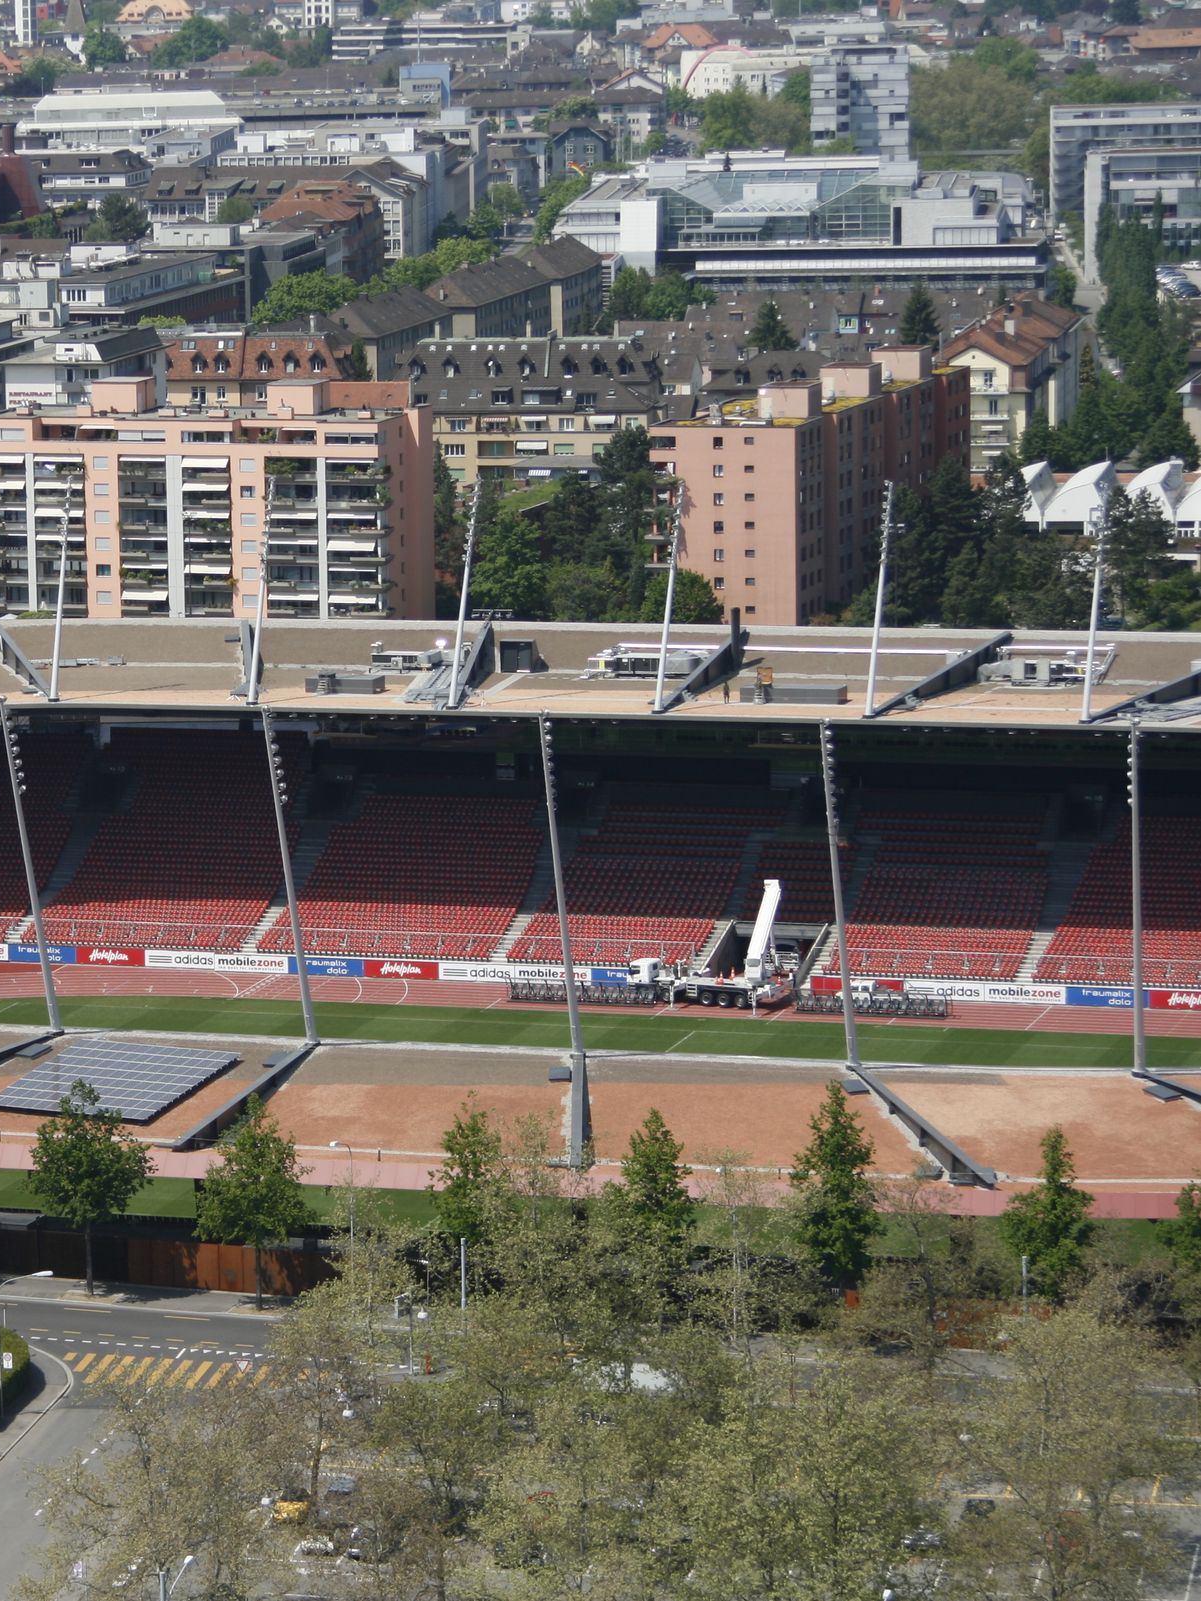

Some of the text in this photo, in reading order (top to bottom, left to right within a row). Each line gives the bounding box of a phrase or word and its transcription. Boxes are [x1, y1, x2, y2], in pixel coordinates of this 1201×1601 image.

[89, 948, 129, 963] Hotelplan
[174, 955, 214, 965] adidas
[218, 957, 285, 967] mobilezone
[380, 962, 422, 976] Hotelplan
[469, 968, 511, 978] adidas
[518, 969, 588, 979] mobilezne
[936, 986, 980, 997] adidas
[988, 987, 1061, 998] mobilezone
[1108, 998, 1132, 1006] dolo
